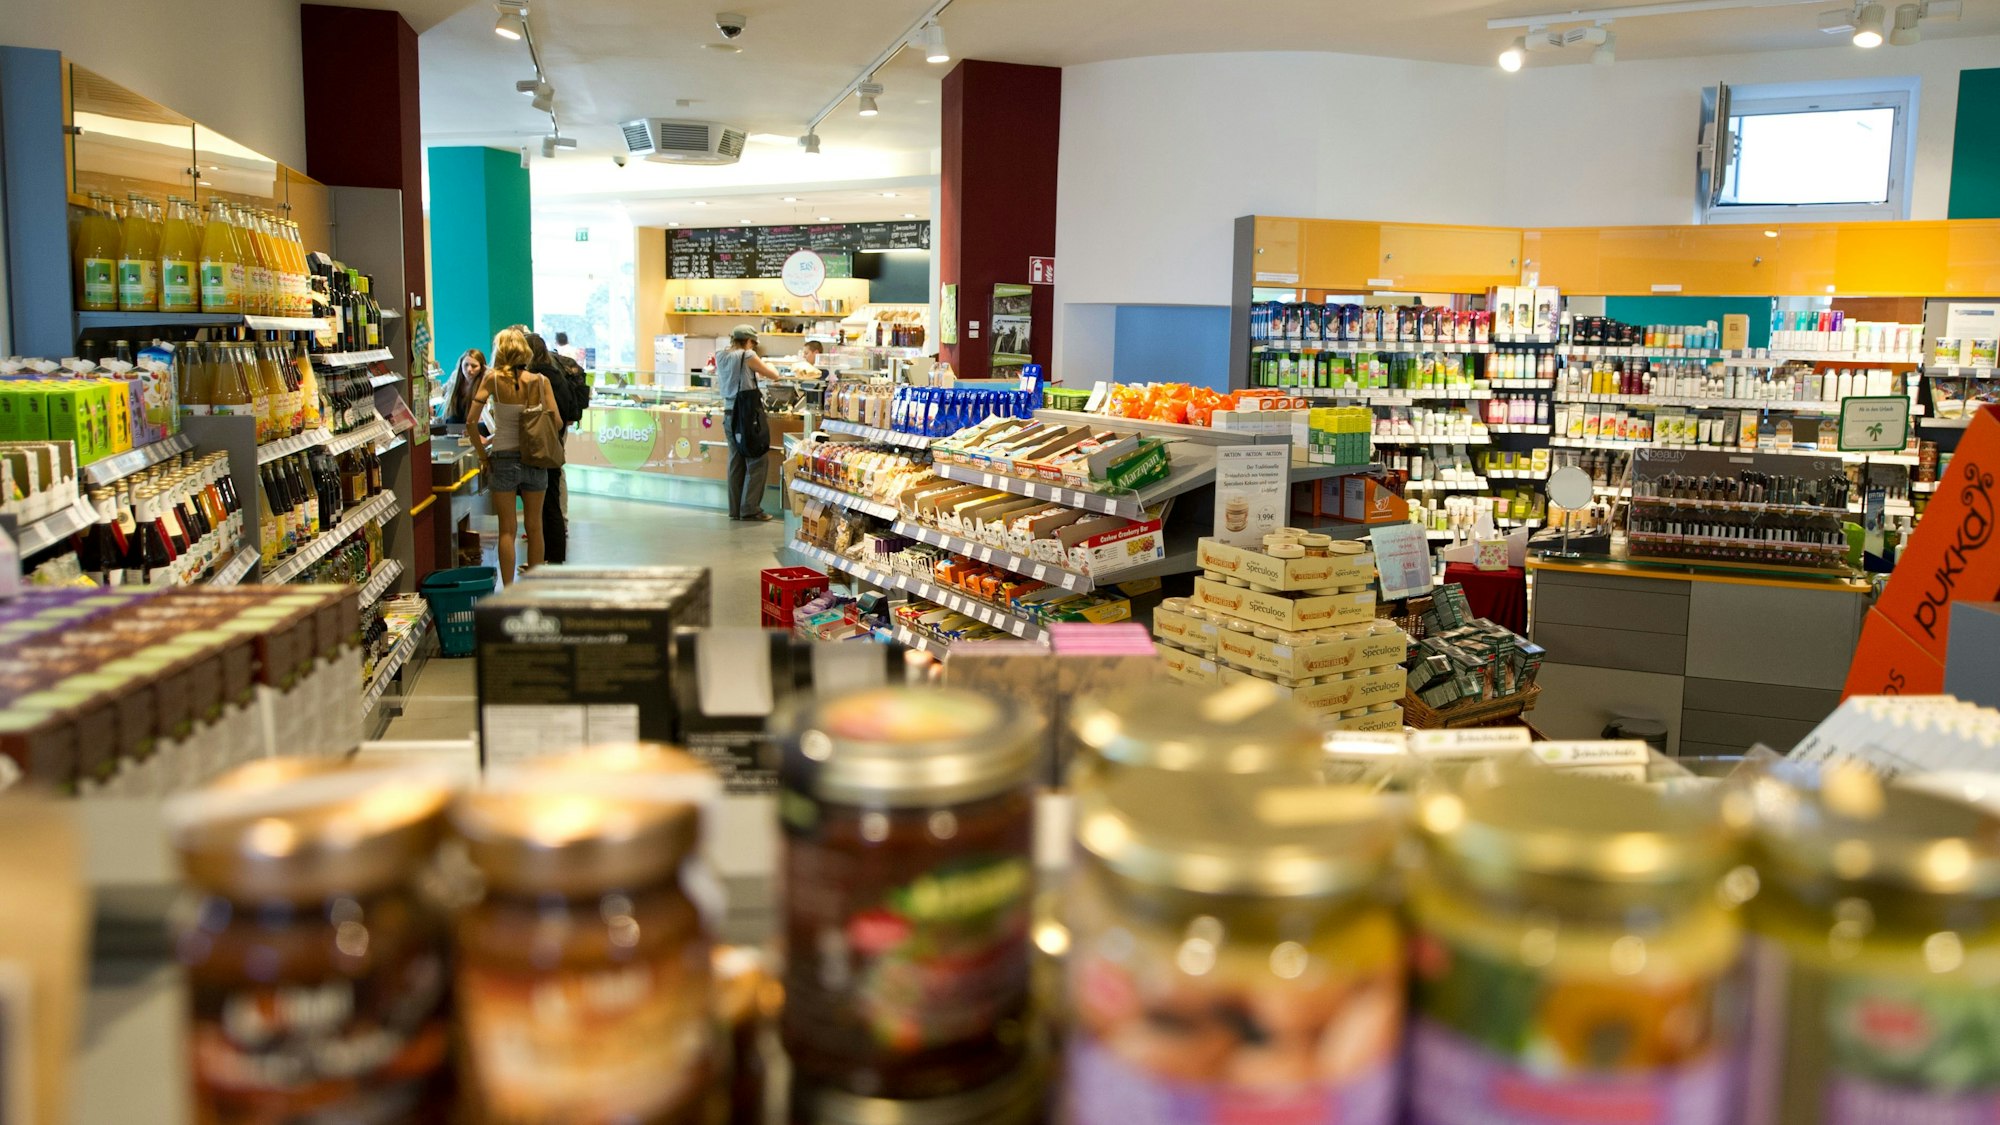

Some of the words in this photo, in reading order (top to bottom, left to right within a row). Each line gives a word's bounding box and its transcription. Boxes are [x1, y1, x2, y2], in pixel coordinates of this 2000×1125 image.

[1650, 450, 1686, 461] beauty
[1120, 453, 1159, 488] Marzipan
[1100, 534, 1117, 543] Cashew
[1118, 527, 1140, 538] Cranberry
[1246, 562, 1278, 579] Speculoos
[1249, 601, 1285, 618] Speculoos
[1362, 644, 1400, 659] Speculoos
[1361, 681, 1399, 696] Speculoos
